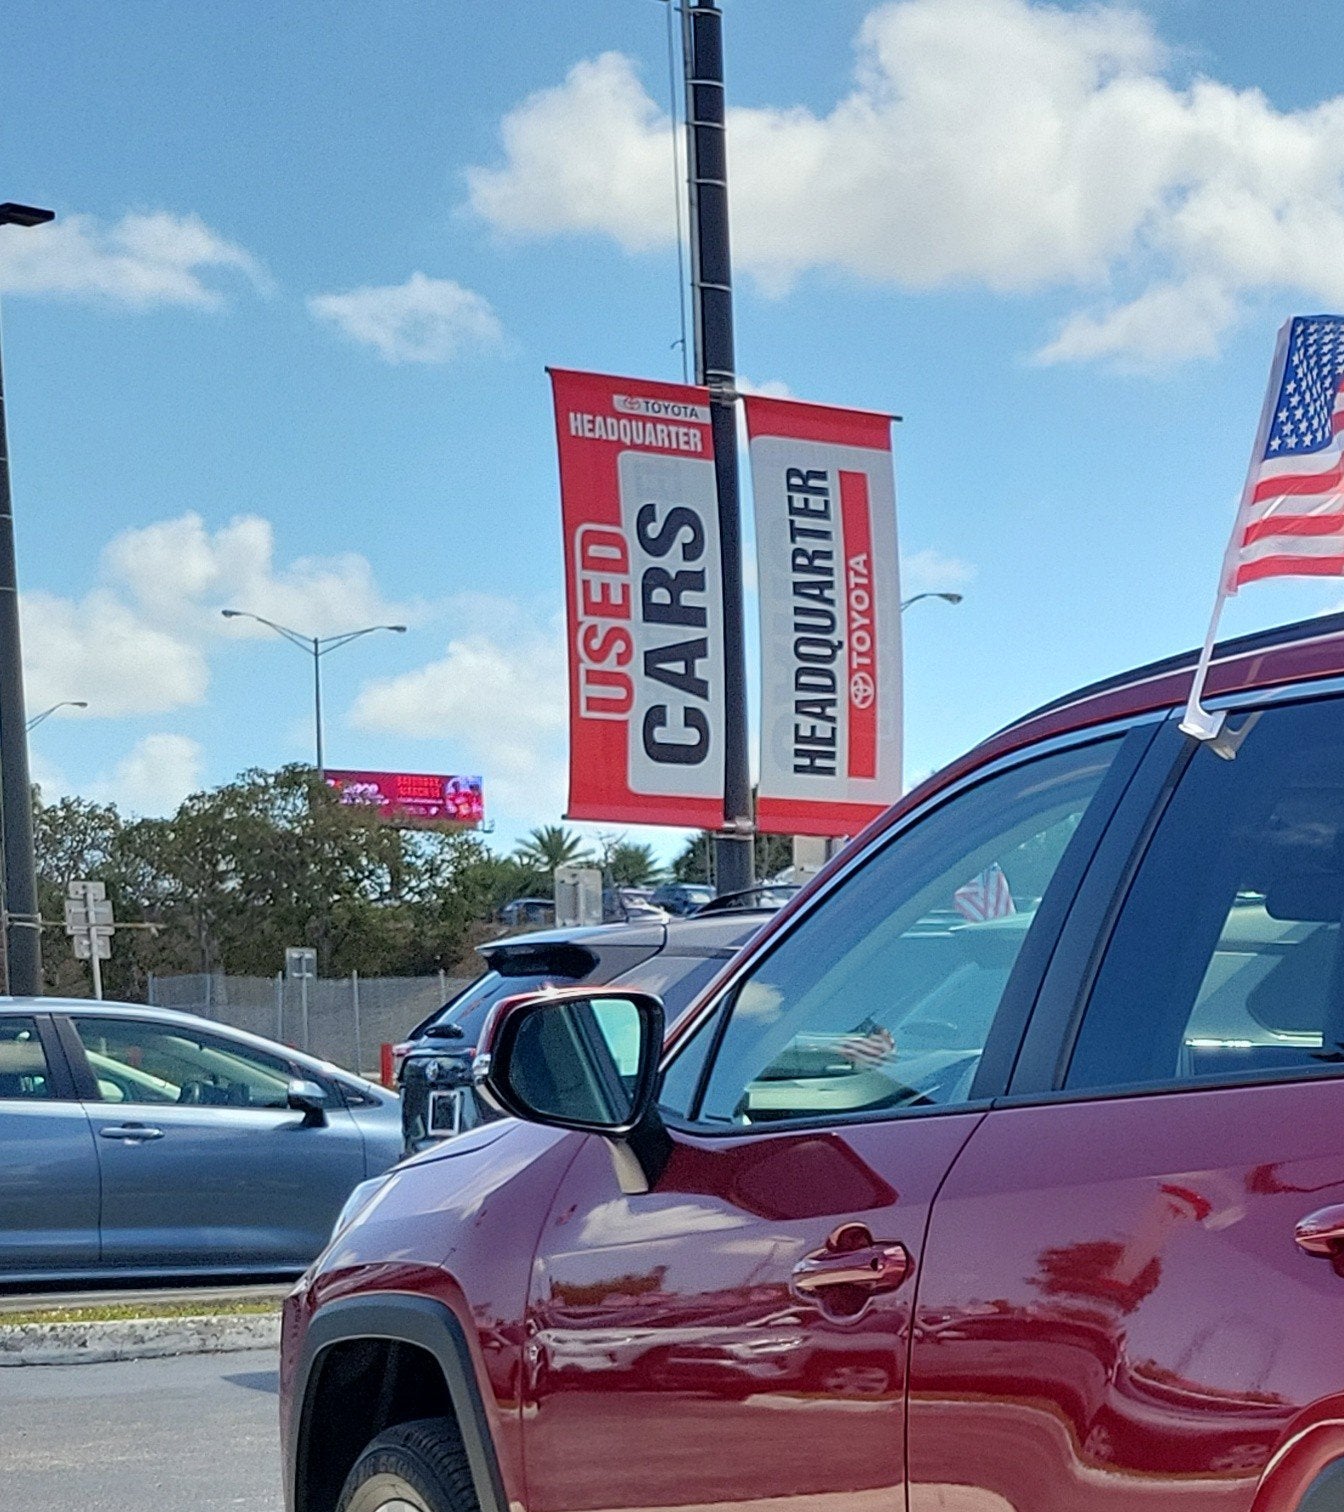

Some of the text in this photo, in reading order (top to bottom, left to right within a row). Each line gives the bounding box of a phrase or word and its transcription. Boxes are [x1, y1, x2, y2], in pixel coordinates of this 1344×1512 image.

[568, 411, 703, 452] HEADQUARTER
[643, 400, 700, 420] TOYOTA
[578, 525, 635, 719] USED
[636, 503, 711, 766] CARS
[785, 466, 843, 776] HEADQUARTER
[849, 552, 876, 670] TOYOTA
